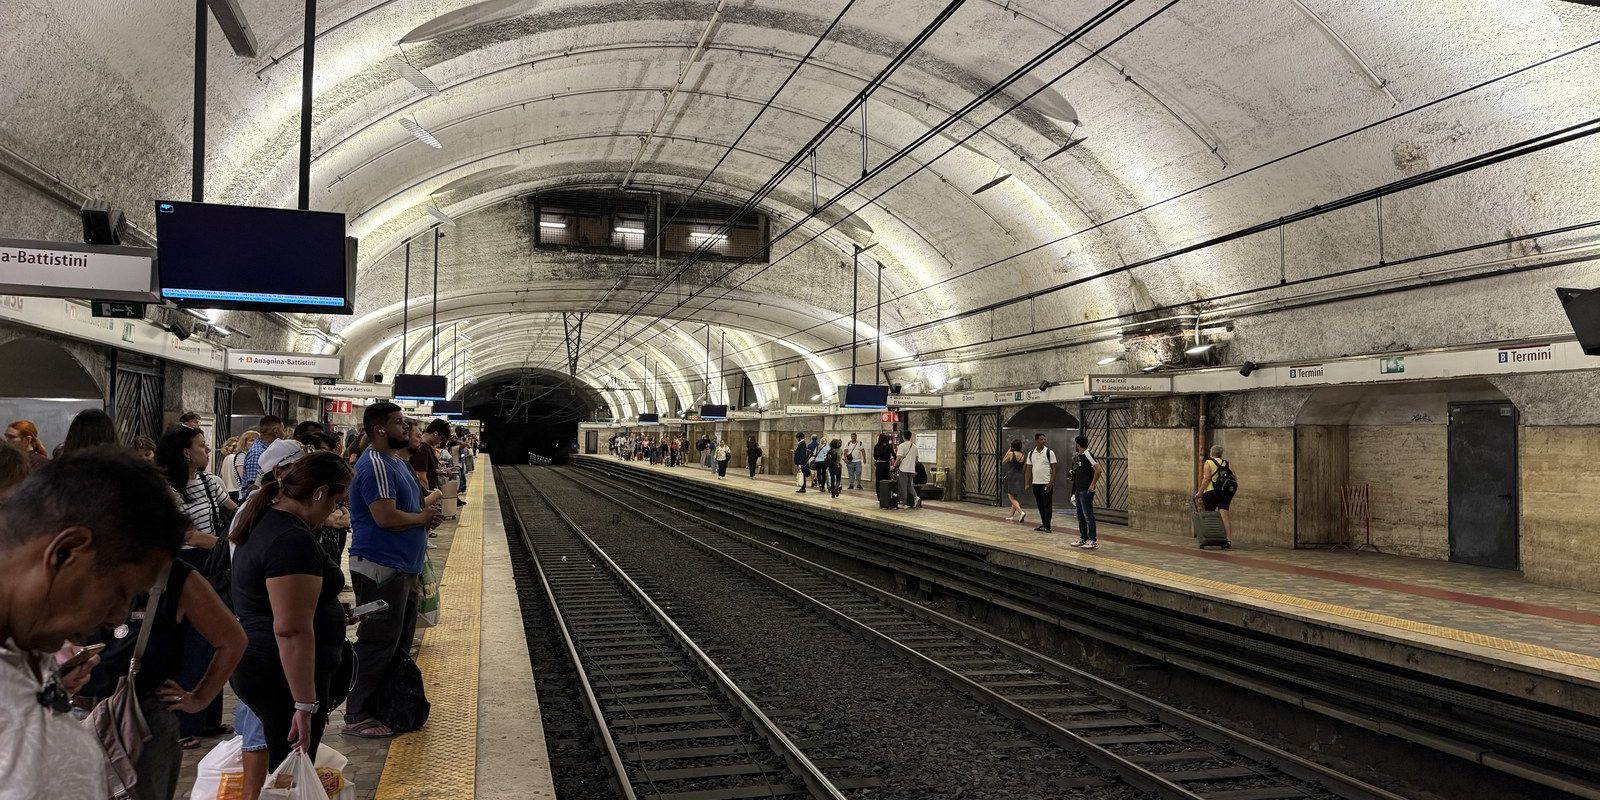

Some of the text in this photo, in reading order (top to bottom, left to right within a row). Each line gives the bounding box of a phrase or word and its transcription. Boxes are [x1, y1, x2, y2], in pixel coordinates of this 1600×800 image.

[1, 250, 88, 268] a-Battistini
[1511, 348, 1551, 362] Termini
[254, 357, 316, 366] Anagnina-Battistini
[1298, 367, 1324, 378] Termini
